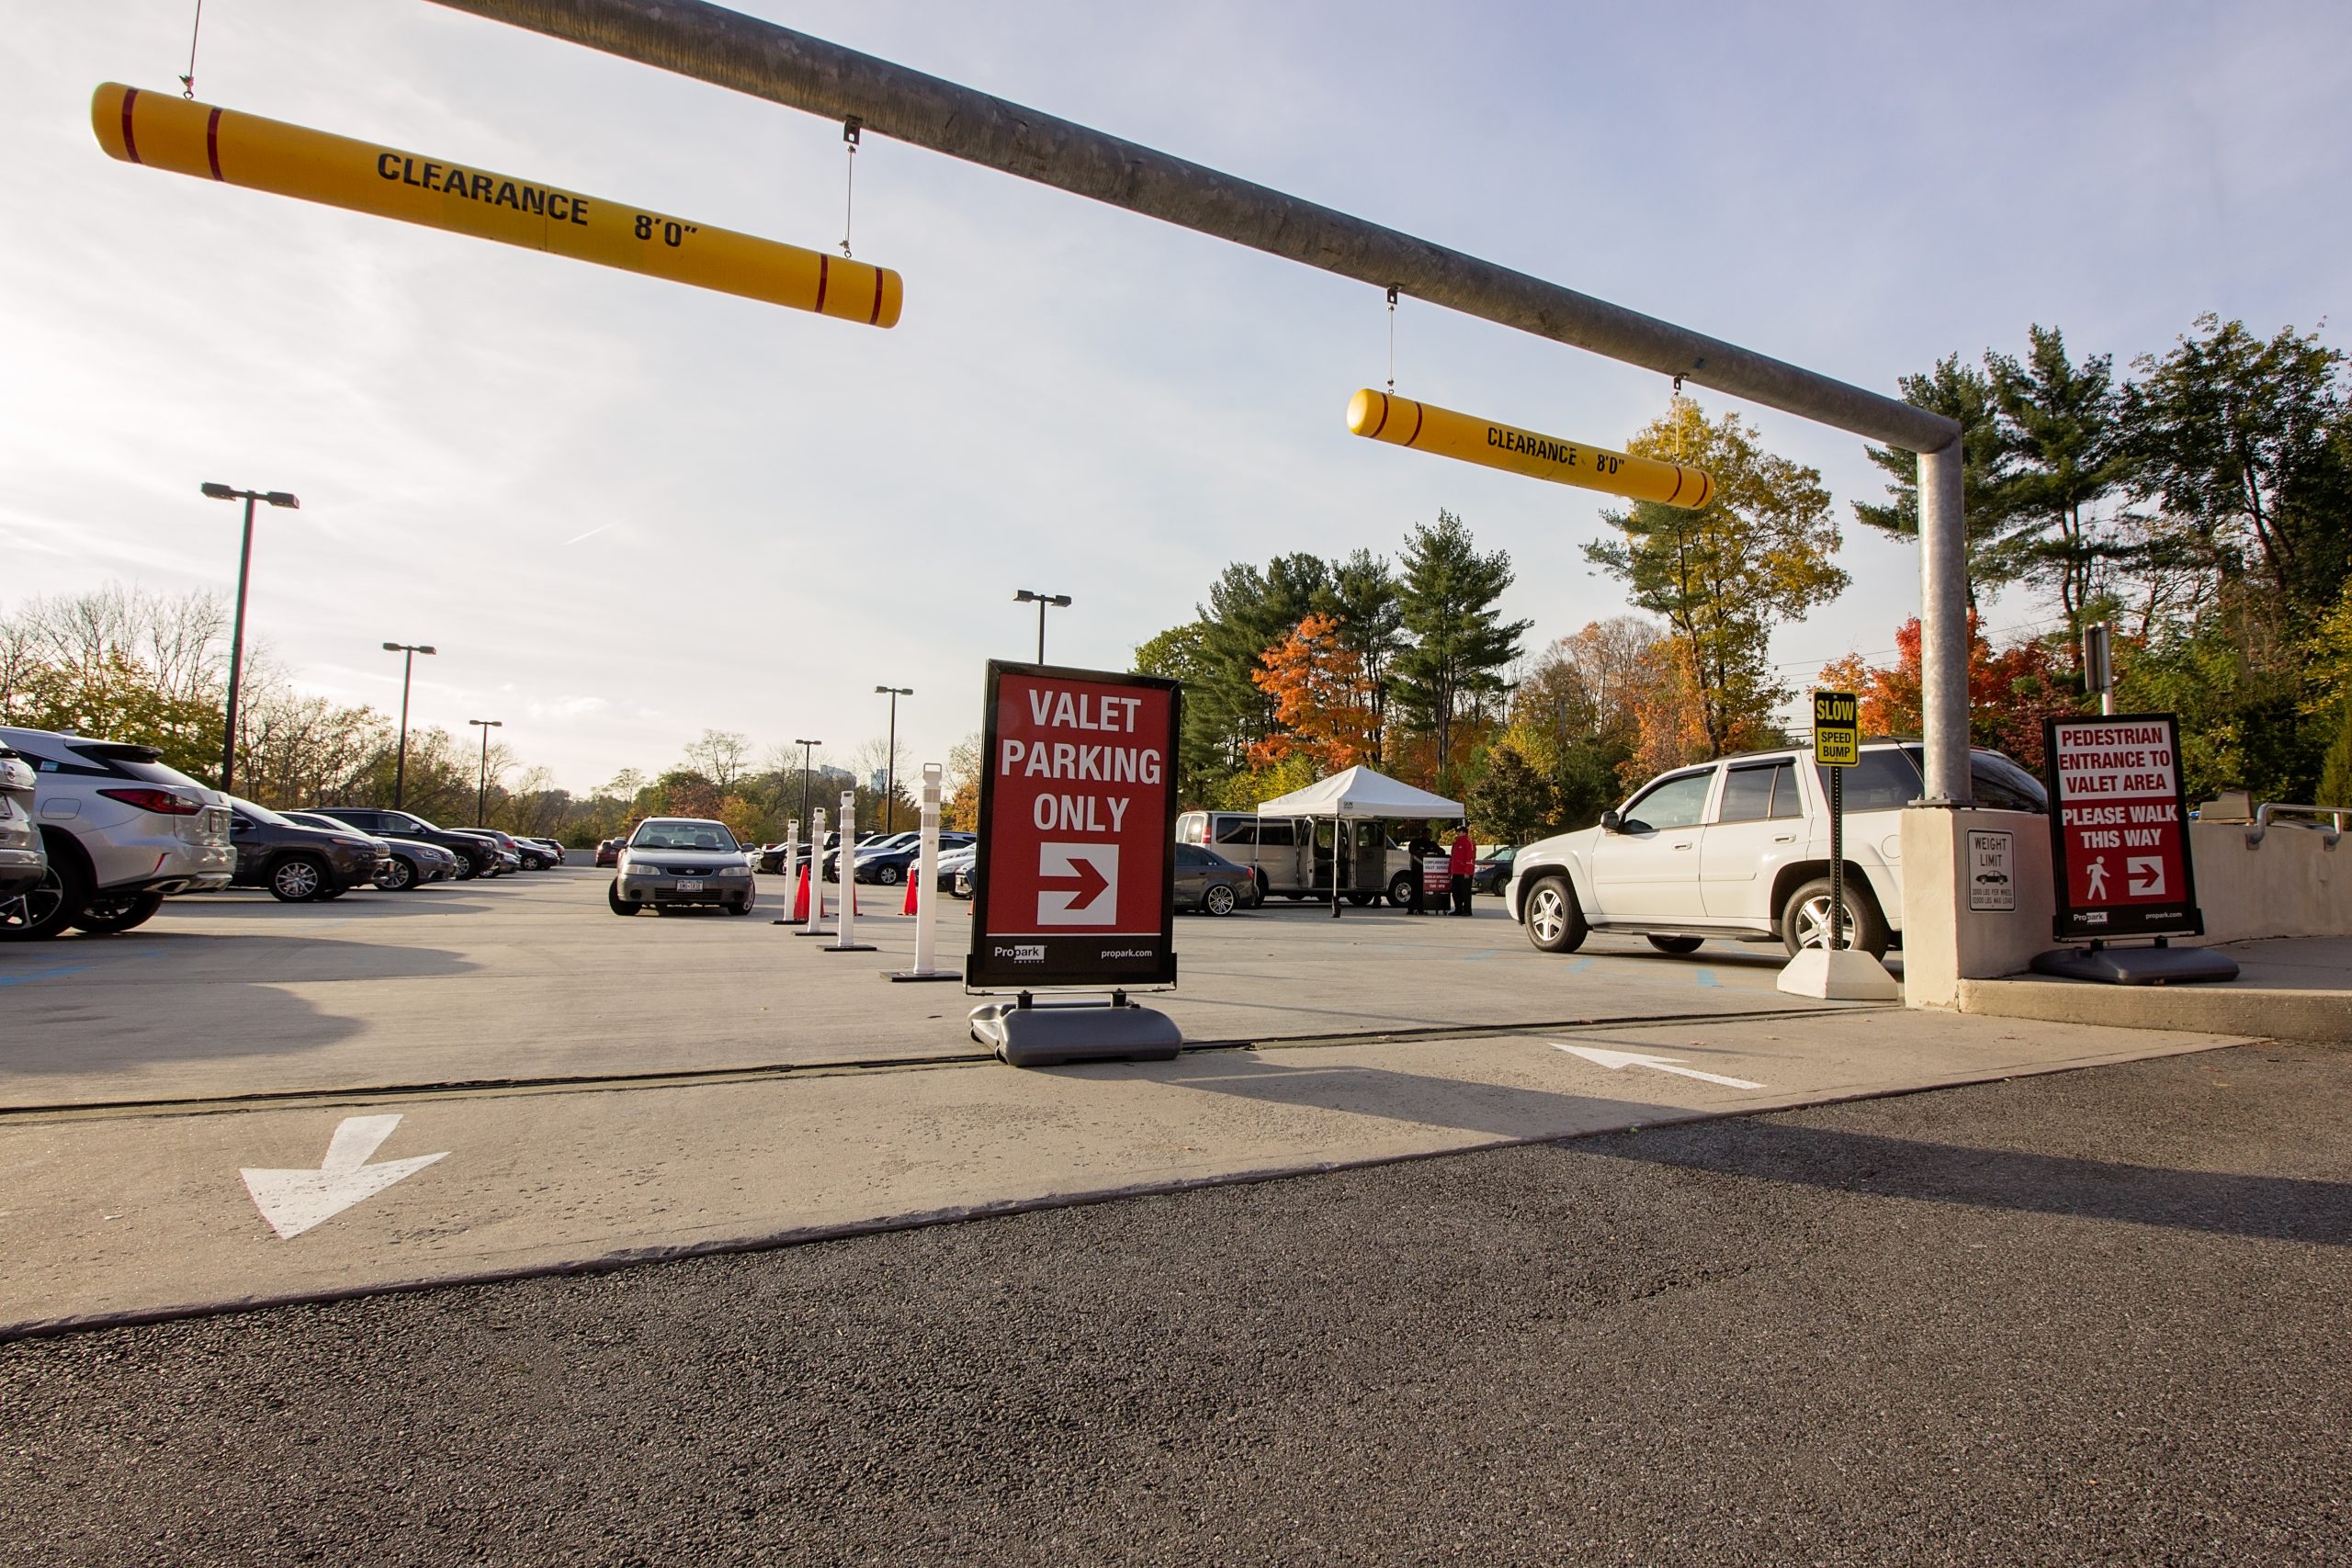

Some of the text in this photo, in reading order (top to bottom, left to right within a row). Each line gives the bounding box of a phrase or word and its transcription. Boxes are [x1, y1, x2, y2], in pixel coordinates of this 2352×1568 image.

[377, 152, 698, 248] CLEARANCE 8'0"
[1487, 426, 1577, 467] CLEARANCE
[1028, 689, 1142, 733] VALET
[1816, 699, 1854, 721] SLOW
[1821, 731, 1851, 743] SPEED
[2061, 727, 2164, 747] PEDESTRIAN
[1001, 739, 1161, 784] PARKING
[1823, 746, 1850, 758] BUMP
[2058, 750, 2170, 771] ENTRANCE TO
[2065, 773, 2167, 794] VALET AREA
[1033, 793, 1130, 832] ONLY
[2061, 804, 2178, 826] PLEASE WALK
[1974, 837, 2007, 851] WEIGHT
[2080, 829, 2162, 849] THIS WAY
[1980, 853, 2002, 866] LIMIT
[2073, 912, 2182, 921] Propark propark.com
[994, 946, 1153, 960] Propark propark.com
